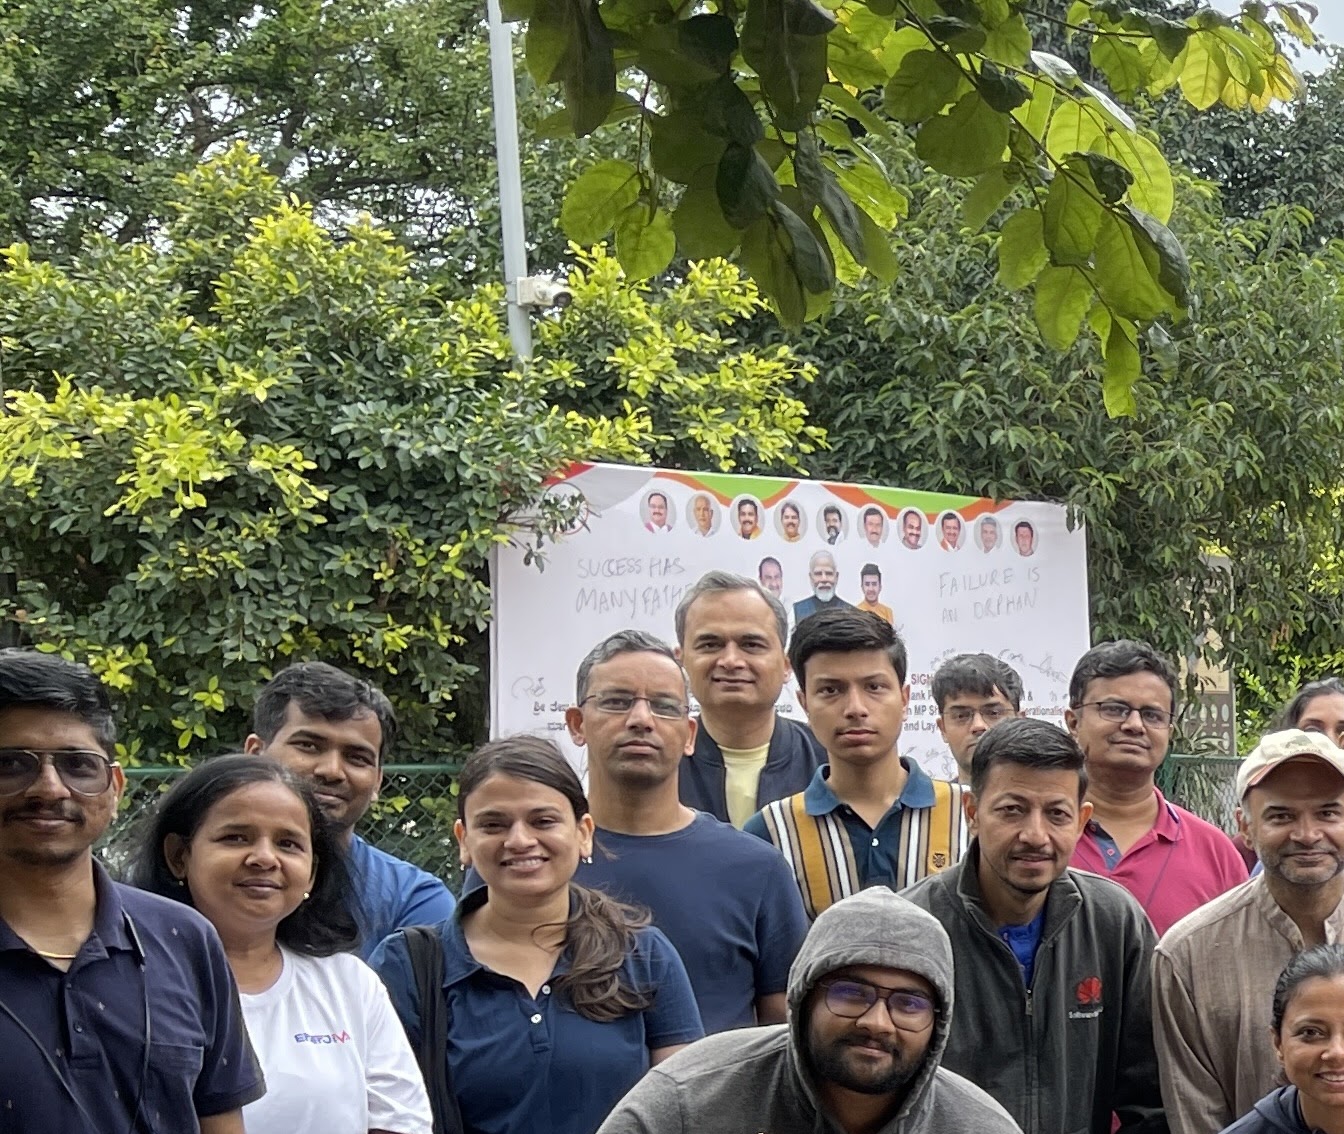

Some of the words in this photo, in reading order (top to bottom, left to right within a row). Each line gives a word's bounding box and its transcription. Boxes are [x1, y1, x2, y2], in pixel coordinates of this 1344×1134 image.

[577, 557, 642, 579] SUCCESS
[649, 557, 686, 577] HAS
[939, 567, 1013, 598] FAILURE
[1027, 566, 1041, 582] IS
[575, 587, 637, 619] MANY
[641, 582, 692, 616] FATH
[942, 607, 958, 624] AN
[973, 588, 1037, 620] ORPHAN
